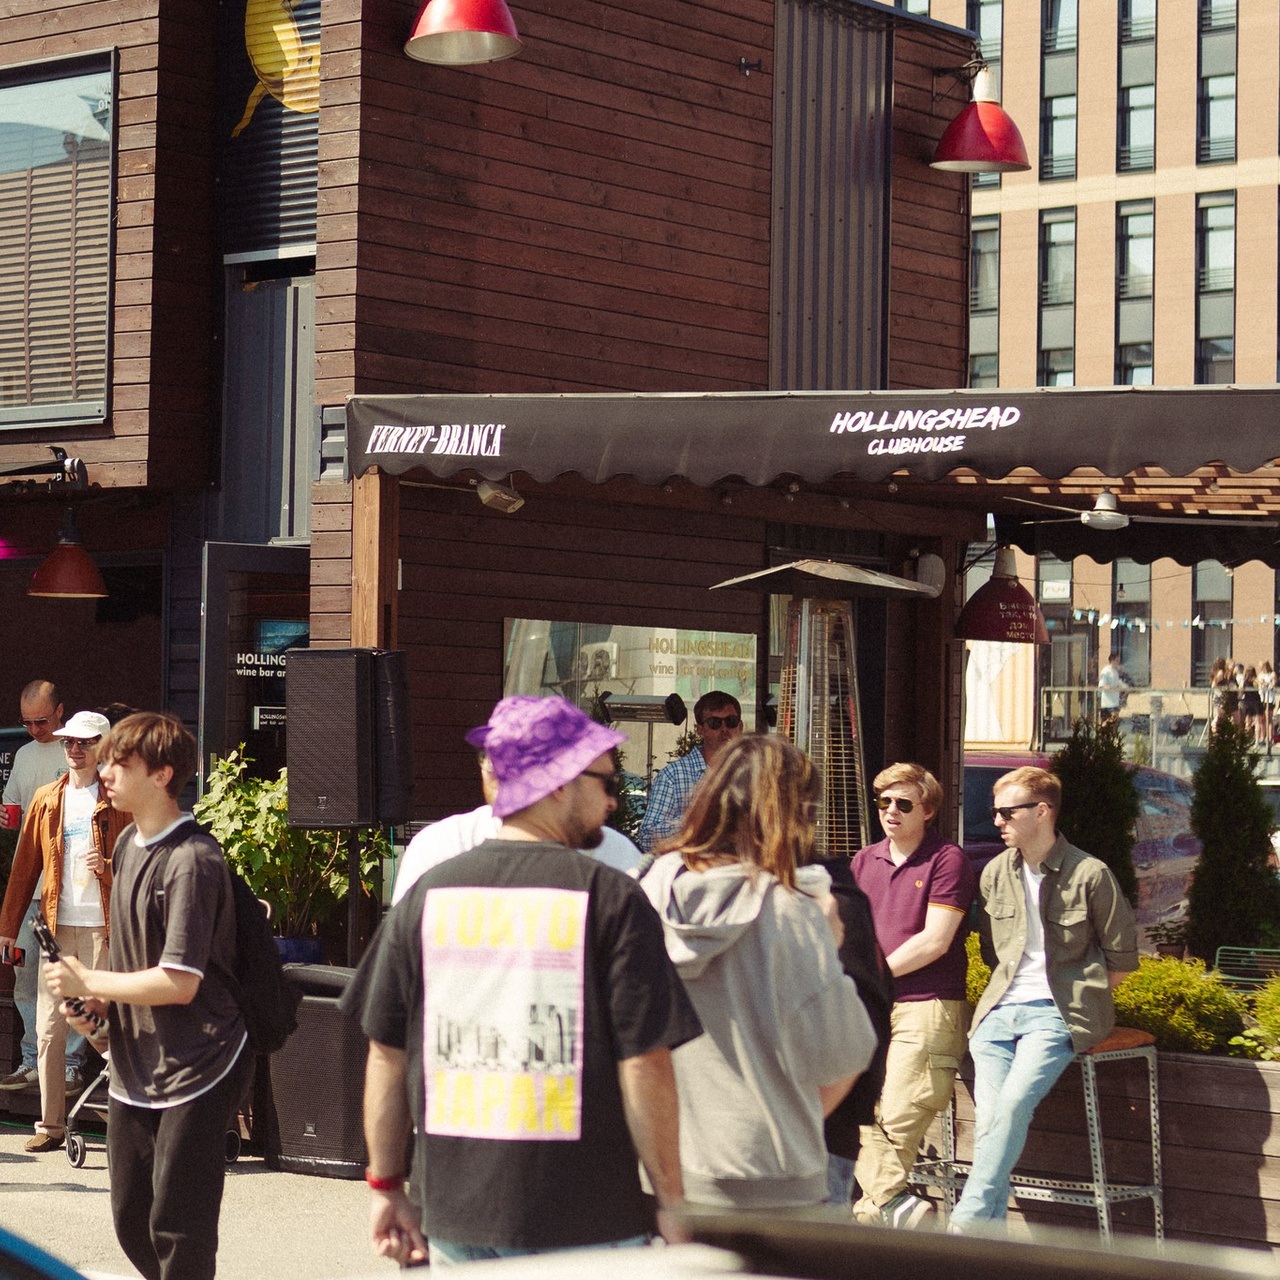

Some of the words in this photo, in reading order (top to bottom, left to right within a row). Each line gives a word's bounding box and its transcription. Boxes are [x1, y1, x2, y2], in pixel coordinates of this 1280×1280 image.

[829, 406, 1021, 434] HOLLINGSHEAD
[867, 435, 967, 455] CLUBHOUSE
[236, 666, 257, 677] wine
[259, 667, 274, 677] bar
[649, 661, 674, 675] wine
[432, 893, 578, 952] TOKYO
[432, 1072, 576, 1134] JAPAN
